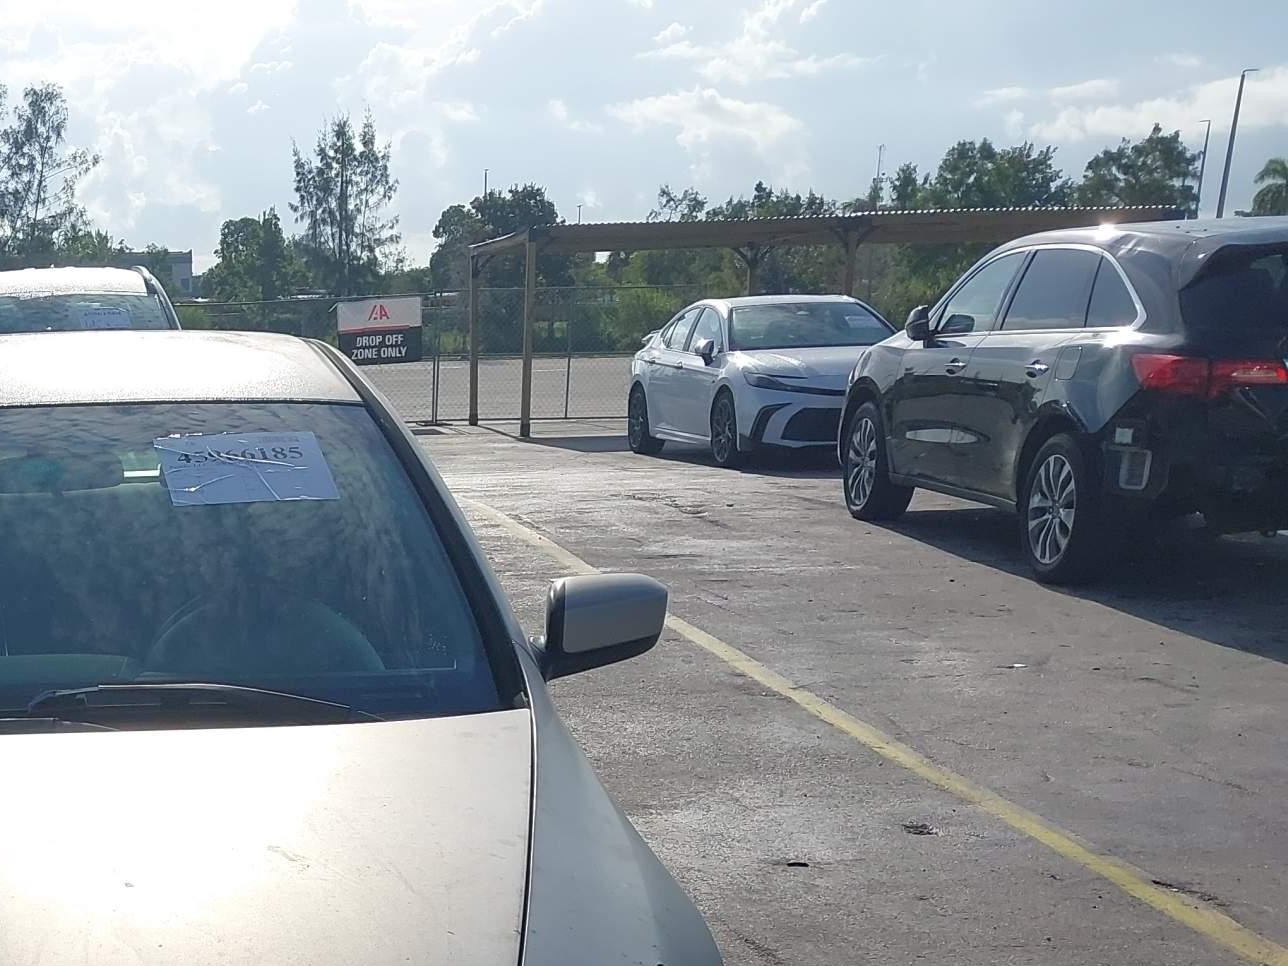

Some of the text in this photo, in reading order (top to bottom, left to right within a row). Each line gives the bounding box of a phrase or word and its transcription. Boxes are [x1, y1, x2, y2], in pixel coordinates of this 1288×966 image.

[356, 334, 404, 348] DROP OFF
[351, 346, 407, 360] ZONE ONLY
